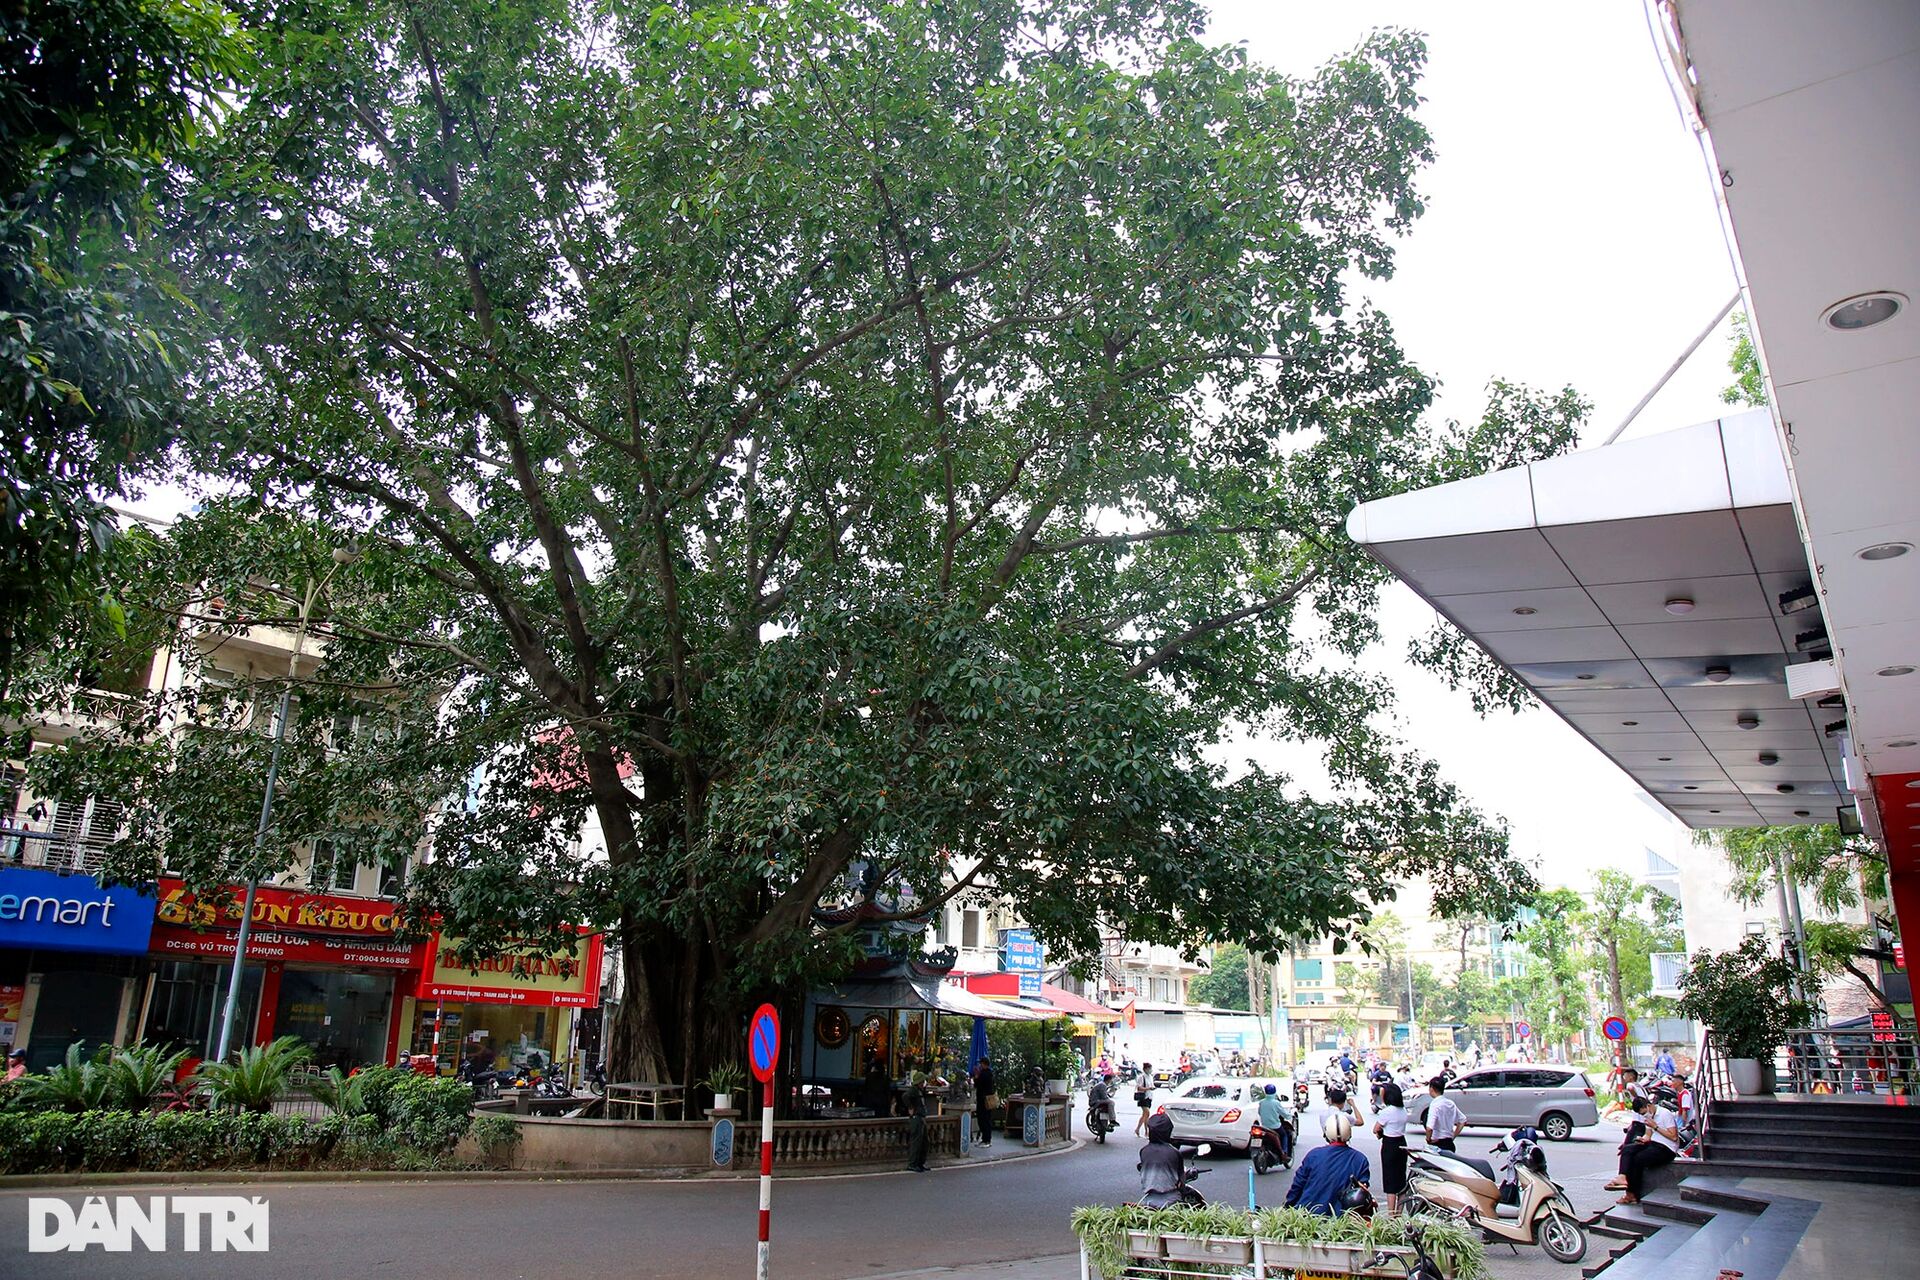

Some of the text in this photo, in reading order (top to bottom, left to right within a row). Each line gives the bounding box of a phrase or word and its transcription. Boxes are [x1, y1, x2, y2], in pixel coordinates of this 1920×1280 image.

[0, 894, 115, 927] emart
[199, 942, 214, 952] VŨ
[217, 944, 250, 955] TRỌG
[251, 947, 284, 957] PHỤNG
